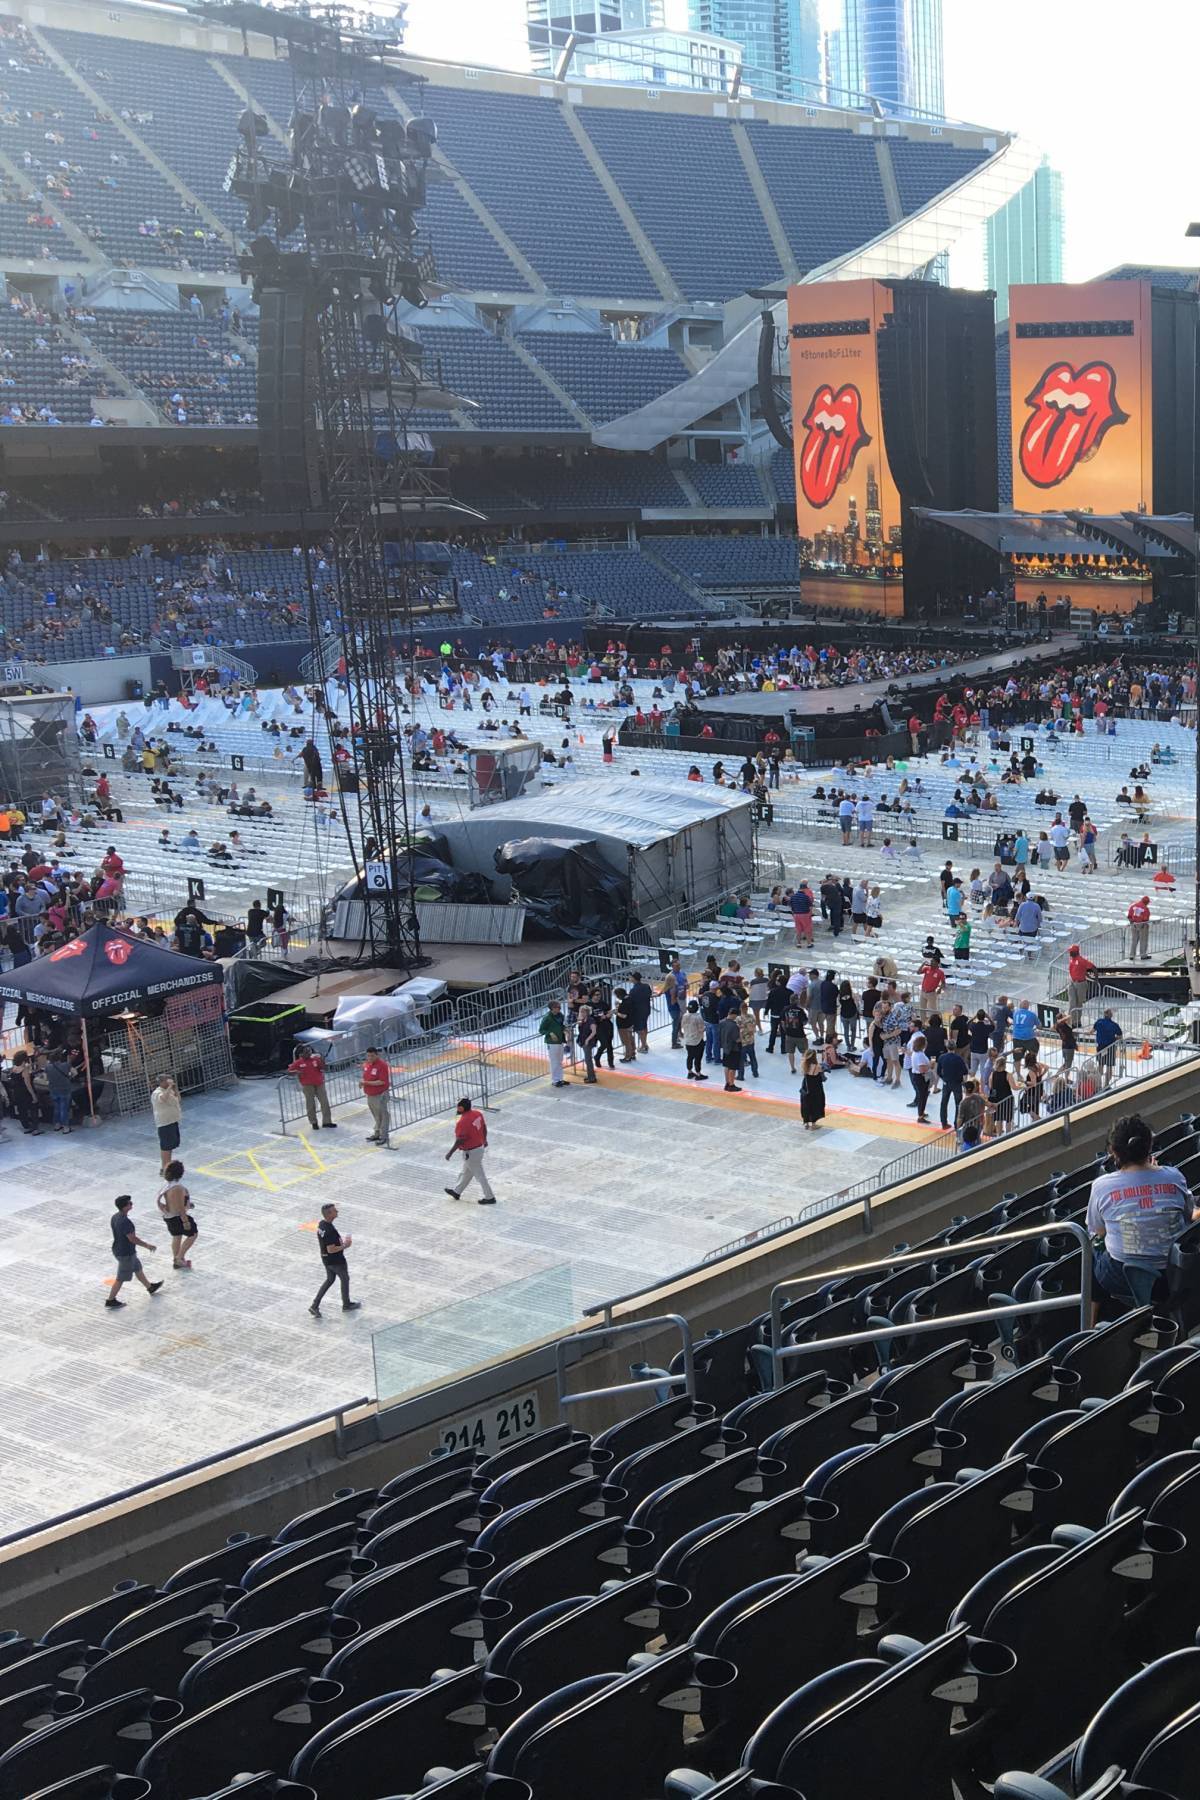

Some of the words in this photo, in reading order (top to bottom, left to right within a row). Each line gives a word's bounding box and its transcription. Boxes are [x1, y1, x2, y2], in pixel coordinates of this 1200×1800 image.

[6, 667, 22, 680] 5W
[106, 746, 112, 756] G
[1024, 740, 1031, 750] B
[234, 757, 241, 768] G
[762, 807, 768, 818] F
[947, 825, 954, 837] F
[1144, 847, 1153, 860] A
[368, 865, 382, 873] PIT
[192, 881, 201, 896] K
[272, 894, 279, 908] J
[92, 989, 142, 1010] OFFICIAL
[147, 972, 214, 996] MERCHANDISE
[27, 991, 76, 1012] MERCHANDISE
[1015, 1014, 1027, 1025] 17
[1043, 1010, 1054, 1027] H
[1110, 1189, 1123, 1202] THE
[1124, 1184, 1153, 1199] ROLLING
[1155, 1183, 1178, 1195] STONES
[1139, 1198, 1154, 1209] LIVE
[444, 1419, 486, 1452] 214
[496, 1399, 536, 1440] 213
